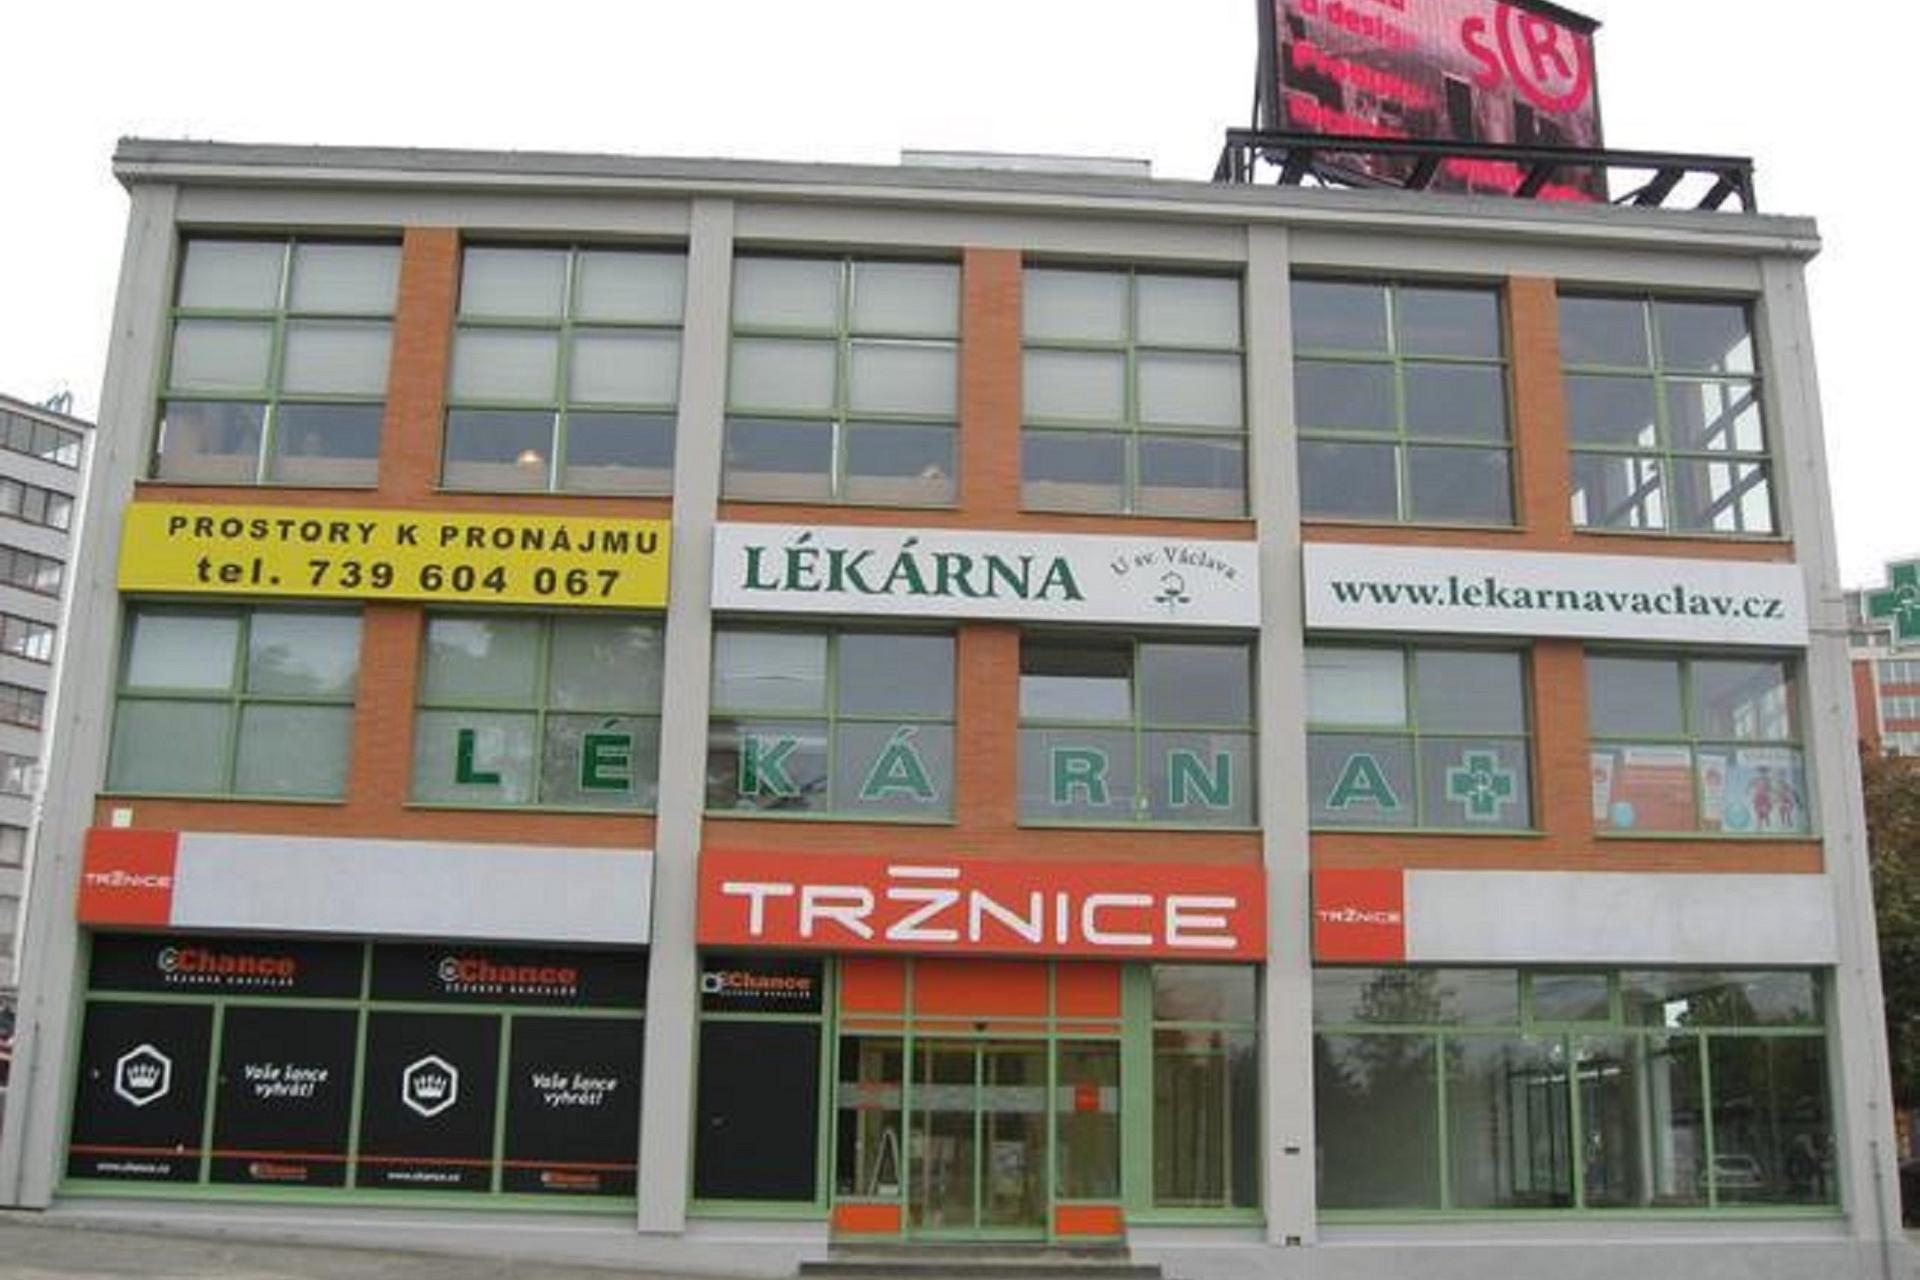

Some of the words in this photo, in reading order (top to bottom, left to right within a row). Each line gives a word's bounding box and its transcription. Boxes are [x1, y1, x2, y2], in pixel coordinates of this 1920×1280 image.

[168, 516, 377, 544] PROSTORY
[397, 524, 419, 545] K
[440, 525, 658, 554] PRONÁJMU
[197, 556, 280, 585] tel.
[309, 560, 395, 588] 739
[419, 564, 507, 593] 604
[534, 567, 620, 597] 067
[742, 531, 1084, 601] LÉKÁRNA
[1332, 576, 1785, 620] www.lekarnavaclav.cz
